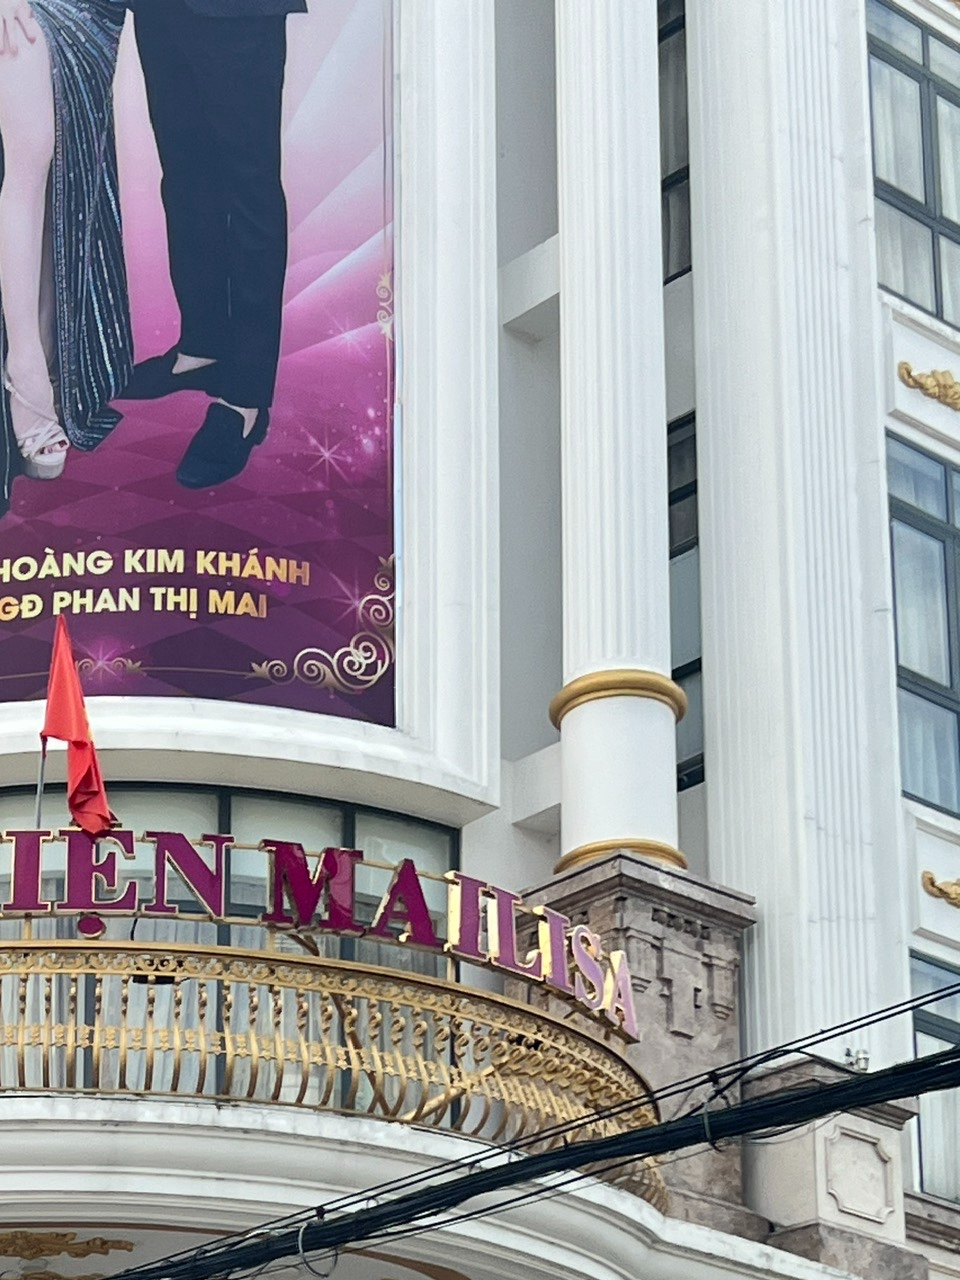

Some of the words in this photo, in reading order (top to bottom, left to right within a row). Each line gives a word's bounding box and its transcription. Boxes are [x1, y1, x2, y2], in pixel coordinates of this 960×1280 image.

[124, 549, 185, 574] KIM
[196, 548, 310, 586] KHÁNH
[52, 587, 141, 616] PHAN
[150, 586, 198, 619] THỊ
[208, 589, 268, 618] MAI
[259, 838, 639, 1043] MAILISA
